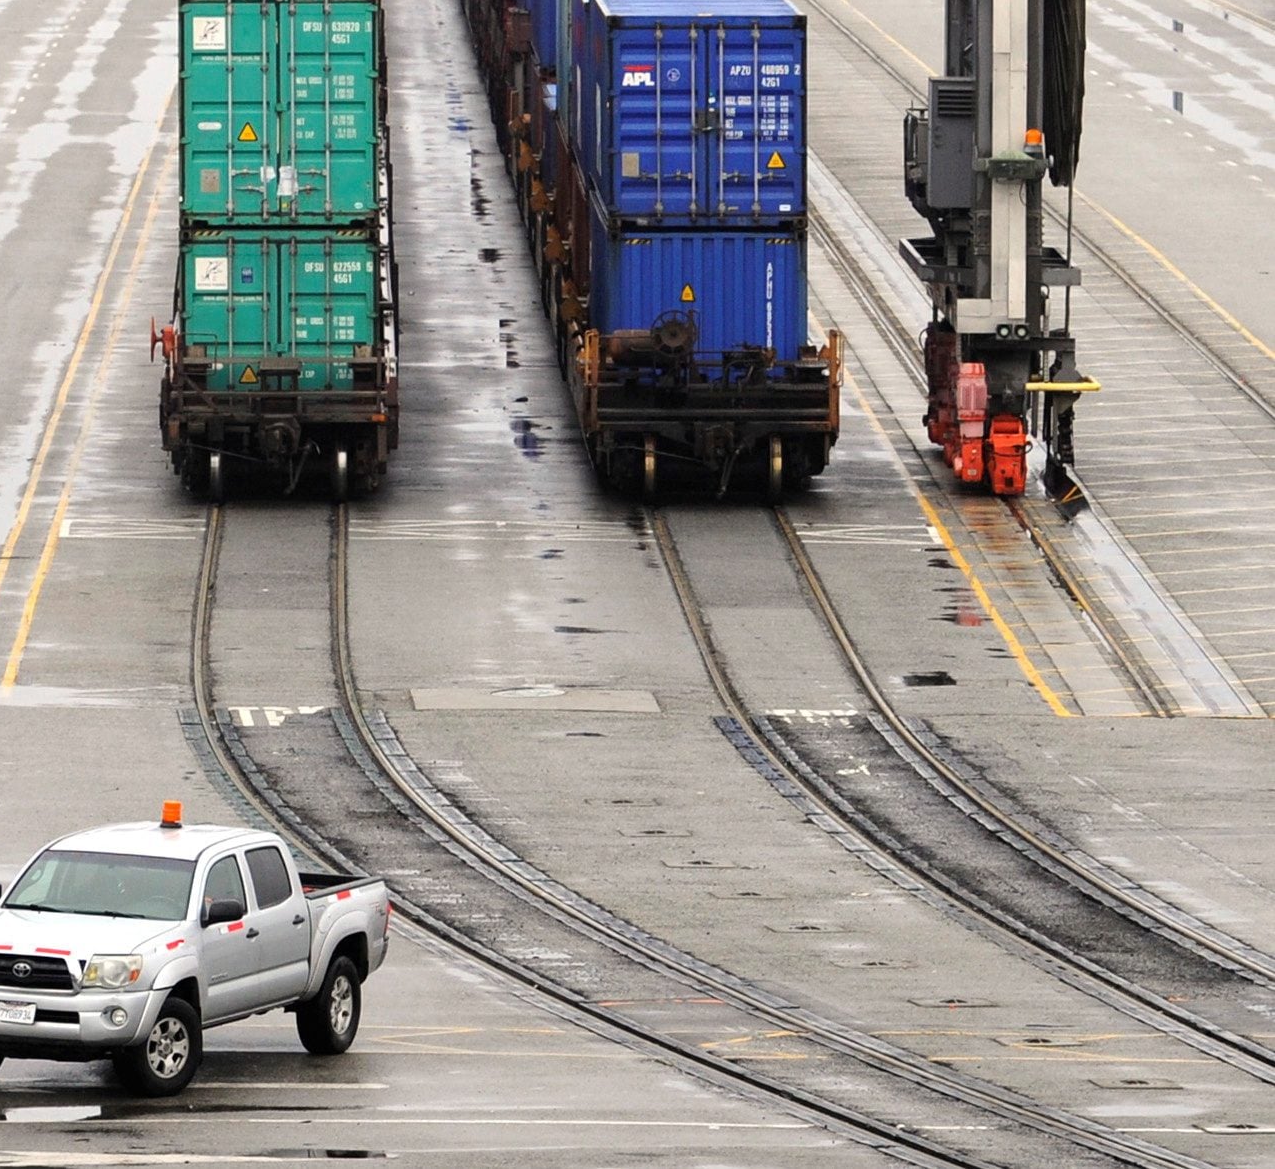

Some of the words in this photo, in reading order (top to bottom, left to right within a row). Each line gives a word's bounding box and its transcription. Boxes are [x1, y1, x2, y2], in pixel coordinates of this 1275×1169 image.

[331, 33, 351, 45] 45G1
[730, 64, 752, 76] APZU
[793, 63, 802, 76] 2
[622, 72, 655, 87] APL
[761, 76, 781, 88] 42G1
[333, 273, 353, 285] 45G1
